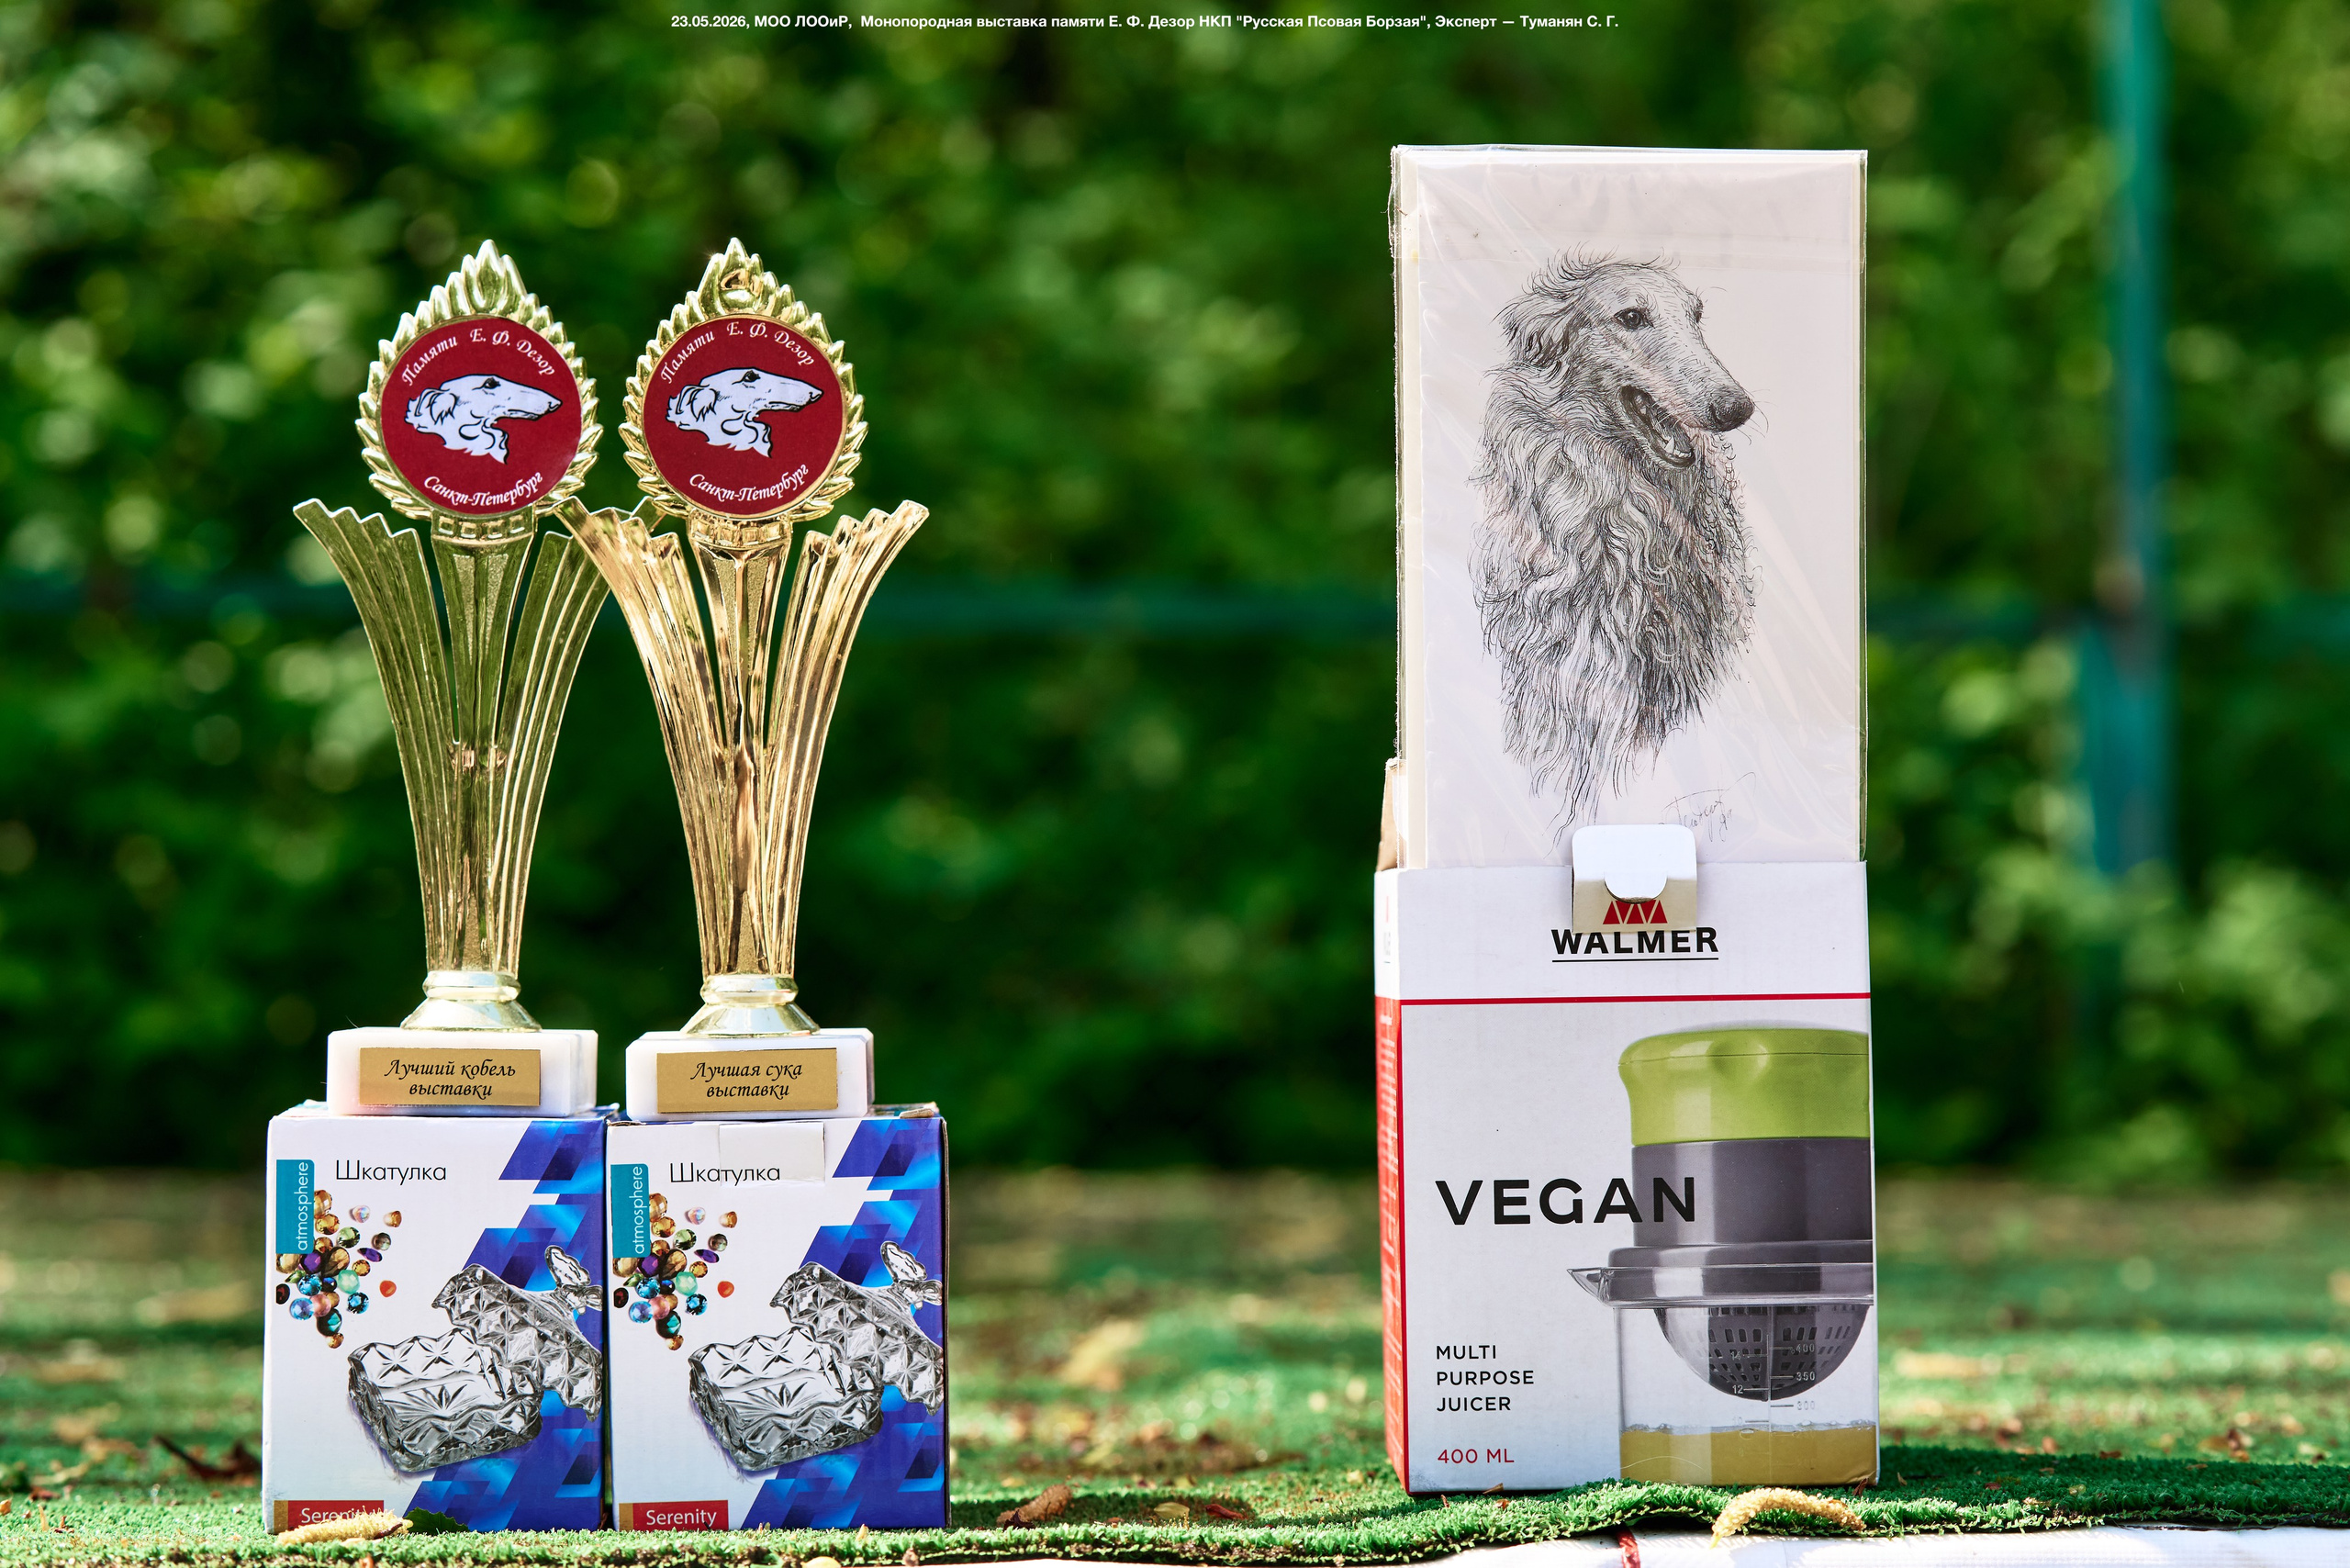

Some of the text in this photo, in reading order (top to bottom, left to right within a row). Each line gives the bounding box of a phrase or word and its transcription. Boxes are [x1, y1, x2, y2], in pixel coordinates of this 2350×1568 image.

[401, 328, 555, 386] Памяти Е. Ф. Дезор
[660, 321, 815, 384] Памяти Е. Ф. Дезор
[423, 471, 543, 507] Санкт-Петербург
[688, 464, 810, 503] Санкт-Петербург
[1550, 926, 1718, 955] WALMER
[383, 1058, 516, 1081] Лучший кобель
[689, 1061, 803, 1083] Лучшая сука
[408, 1081, 494, 1100] выставки
[706, 1082, 790, 1101] выставки
[335, 1159, 447, 1186] Шкатулка
[669, 1161, 781, 1186] Шкатулка
[294, 1160, 313, 1252] atmosphere
[629, 1165, 646, 1256] atmosphere
[1435, 1176, 1695, 1226] VEGAN
[1436, 1344, 1497, 1361] MULTI
[1436, 1370, 1535, 1386] PURPOSE
[1732, 1384, 1743, 1394] 12
[1436, 1396, 1512, 1412] JUICER
[1437, 1448, 1515, 1463] 400 ML
[645, 1508, 717, 1527] Serenity
